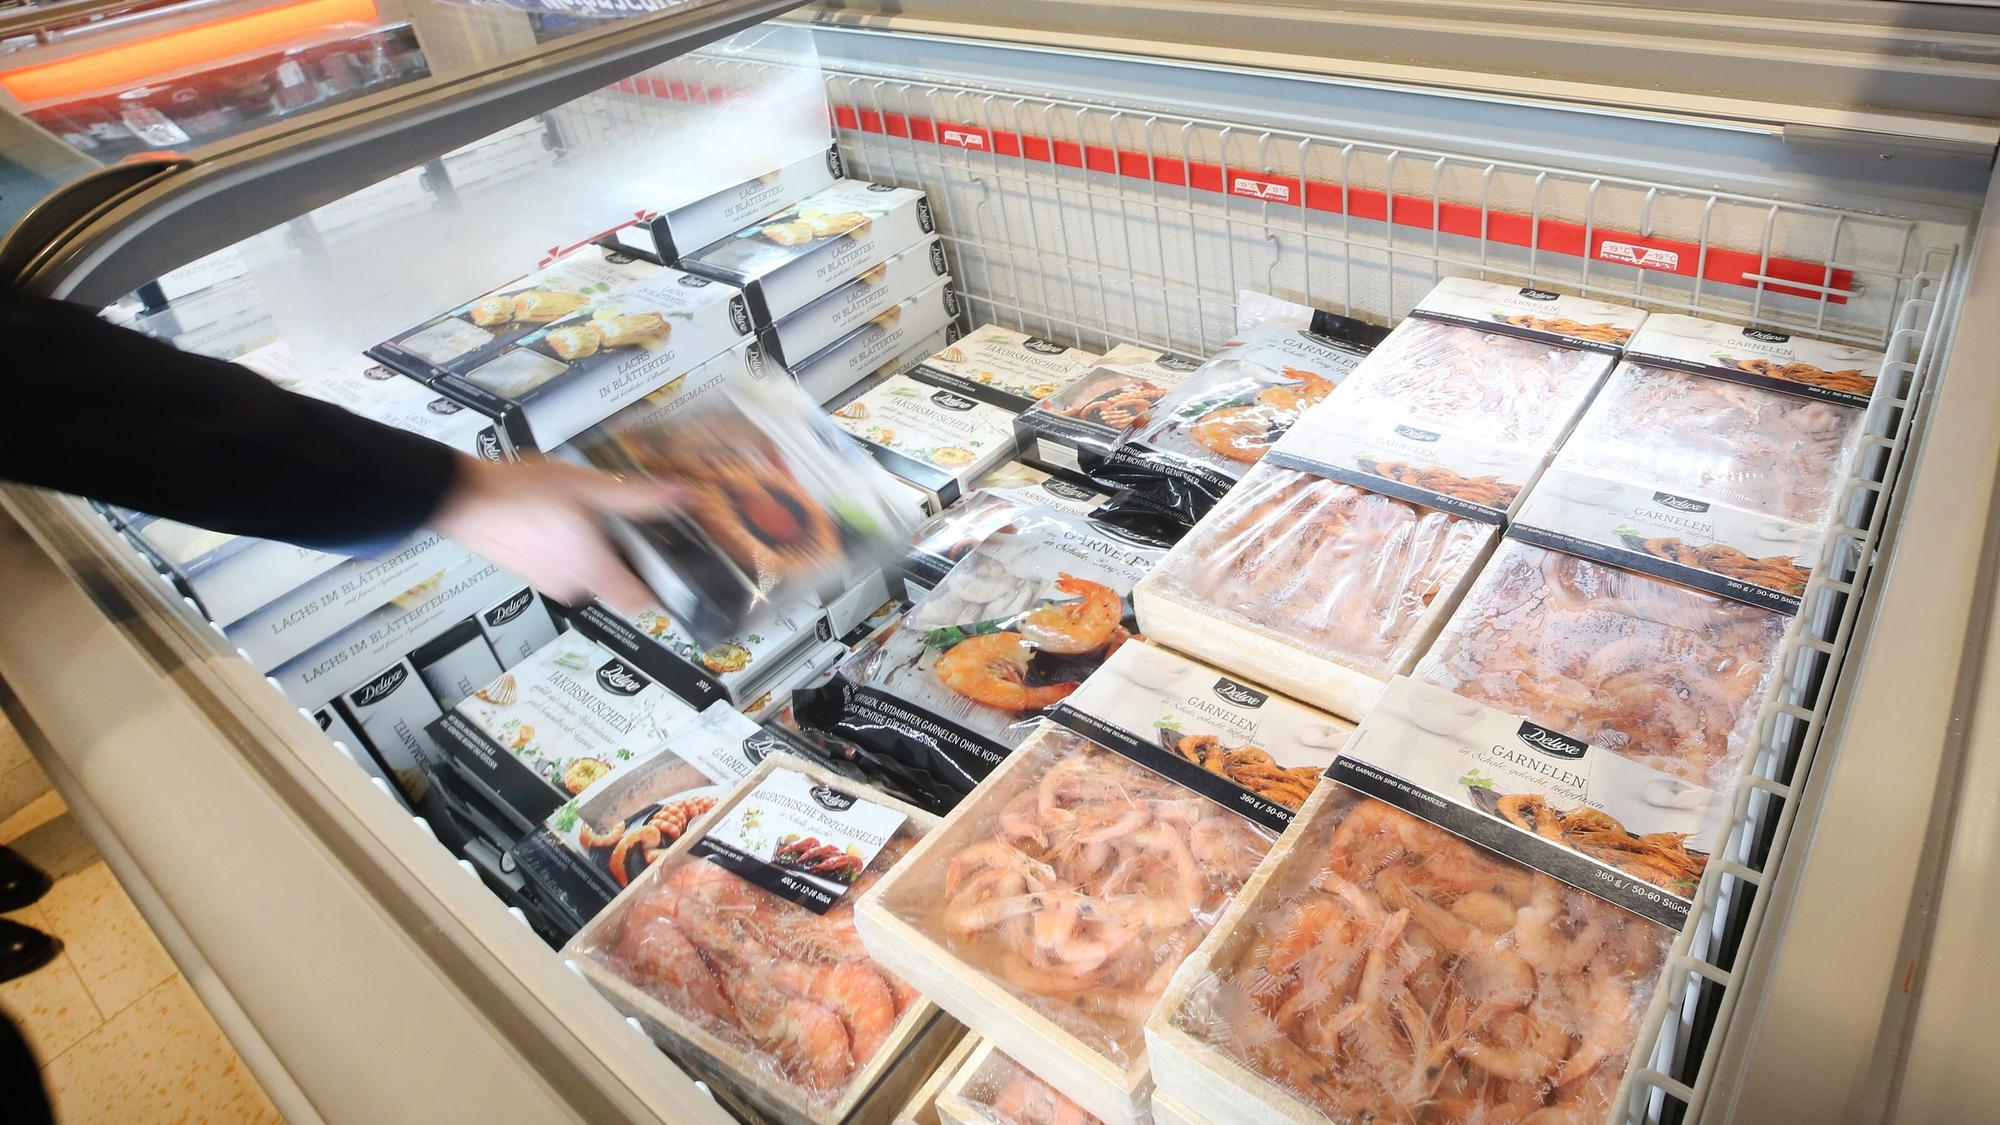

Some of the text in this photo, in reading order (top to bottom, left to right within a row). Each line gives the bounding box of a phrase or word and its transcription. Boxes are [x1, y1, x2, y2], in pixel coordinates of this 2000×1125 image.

[1728, 339, 1793, 356] GARNELEN
[1746, 330, 1786, 343] Deluxe
[618, 351, 651, 374] LACHS
[985, 344, 1072, 374] JAKOBSMUSCHELN
[1283, 338, 1359, 368] GARNELEN
[599, 388, 611, 398] IN
[613, 350, 676, 391] BLÄTTERTEIG
[893, 398, 977, 433] JAKOBSMUSCHELN
[480, 433, 501, 464] Delux
[1115, 453, 1127, 463] DAS
[1127, 456, 1152, 470] RICHTIGE
[1435, 495, 1448, 503] 360
[1458, 502, 1477, 511] 50-60
[1477, 507, 1497, 517] Stücke
[1658, 495, 1705, 511] Deluxe
[1634, 507, 1712, 532] GARNELEN
[272, 533, 445, 634] LACHS IM BLÄTTERTEIGMA
[1727, 580, 1743, 589] 360
[1756, 589, 1780, 600] 50-60
[301, 563, 500, 683] LACHS IM BLÄTTERTEIGMANTEL
[493, 592, 530, 625] Deluxe
[361, 668, 403, 704] Deluxe
[600, 663, 641, 692] Deluxe
[546, 670, 637, 735] JAKOBSMUSCHELN
[1217, 683, 1261, 705] Deluxe
[858, 706, 886, 725] RICHTIGE
[886, 717, 900, 732] FÜR
[1187, 695, 1259, 731] GARNELEN
[880, 702, 921, 725] ENTDARMTEN
[921, 720, 960, 746] GARNELEN
[960, 740, 985, 757] OHNE
[982, 749, 1004, 766] KOPF
[1523, 727, 1580, 755] Deluxe
[712, 748, 749, 777] GARNEL
[1492, 744, 1587, 788] GARNELEN
[1339, 760, 1448, 809] DIESE GARNELEN SIND EINE DELIKATESSE.
[1458, 746, 1470, 755] in
[1550, 783, 1606, 810] tiefgefroren
[751, 789, 818, 821] ARGENTINISCHE
[1240, 793, 1255, 804] 360
[1253, 801, 1261, 809] g
[1265, 806, 1287, 820] 50-60
[781, 876, 791, 888] 400
[815, 892, 832, 905] Stück
[1595, 869, 1614, 882] 360
[1614, 880, 1622, 888] g
[1631, 885, 1661, 903] 50-60
